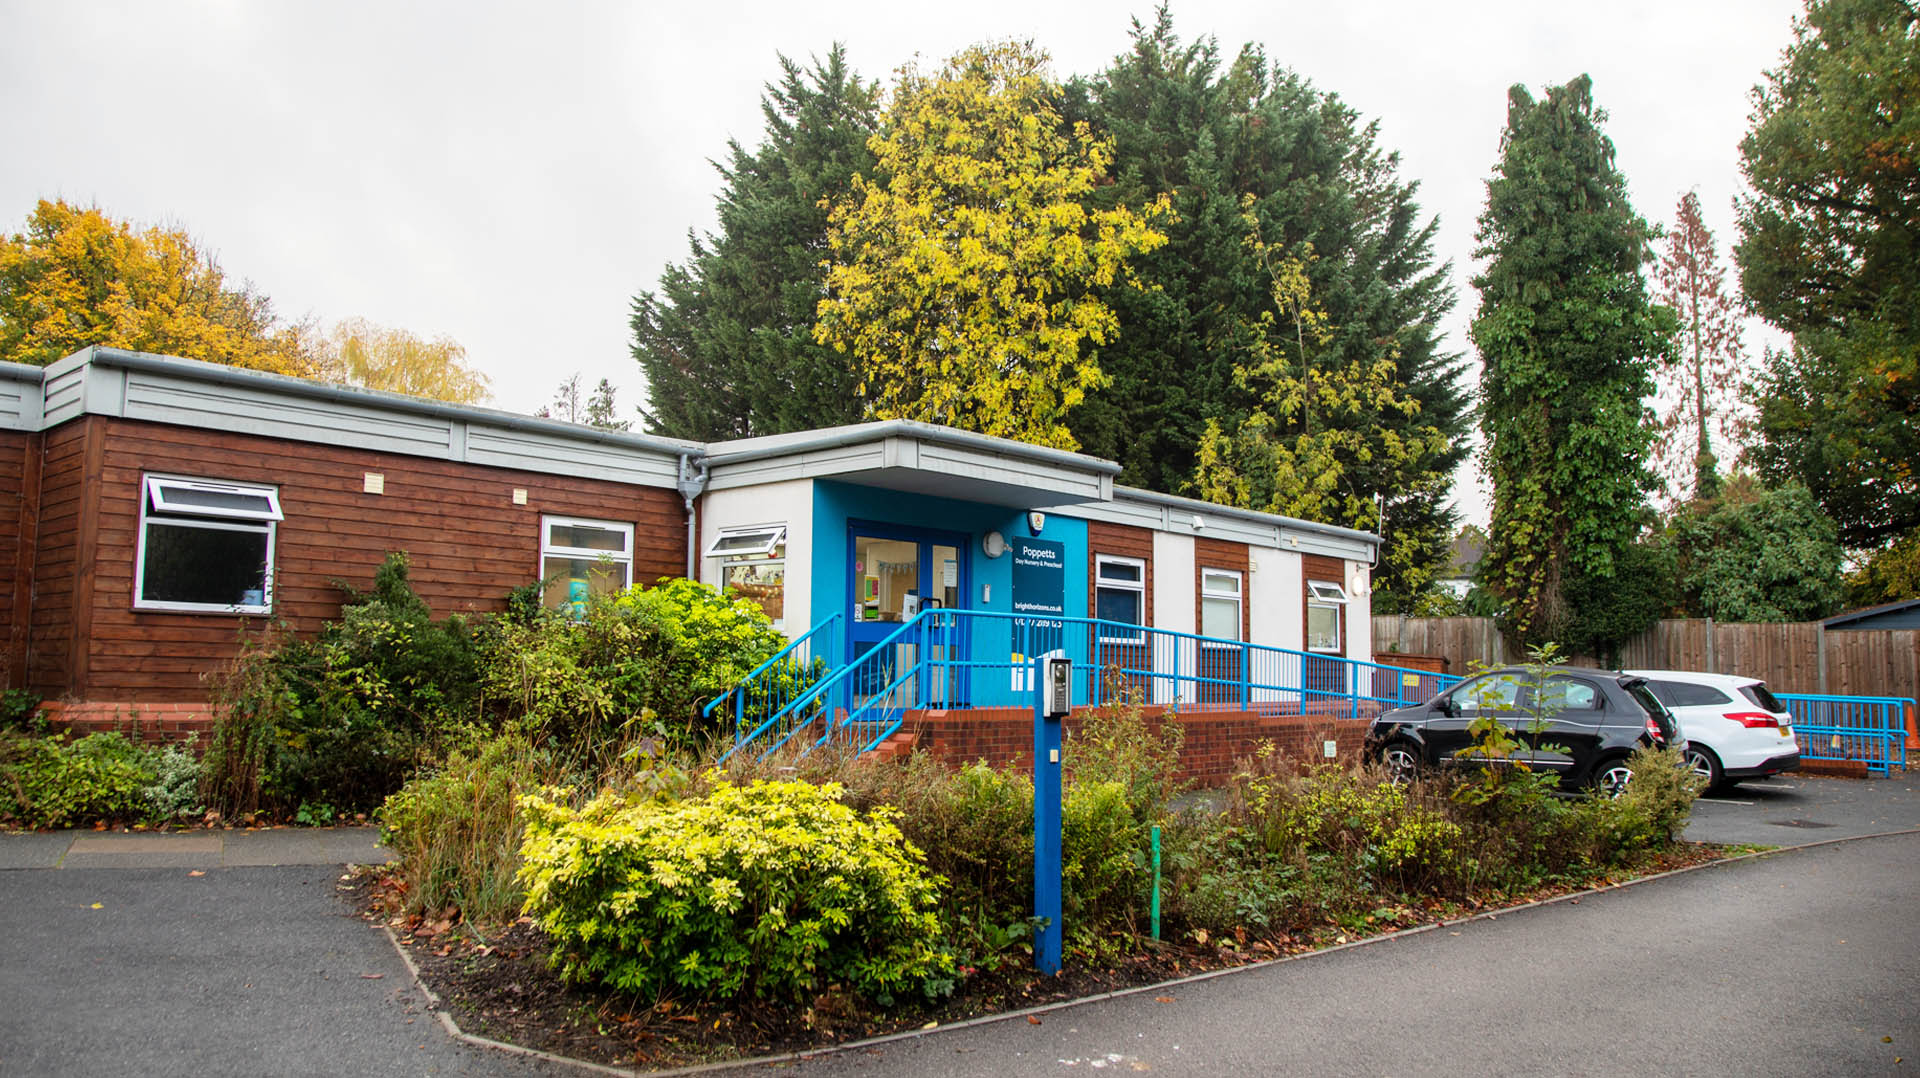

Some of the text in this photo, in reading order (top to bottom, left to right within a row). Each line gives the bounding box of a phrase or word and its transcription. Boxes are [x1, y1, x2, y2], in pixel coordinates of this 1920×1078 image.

[1023, 546, 1056, 559] Poppetts
[1015, 557, 1024, 565] Day
[1024, 559, 1039, 567] Nursery
[1015, 602, 1062, 612] brighthorizons.co.uk
